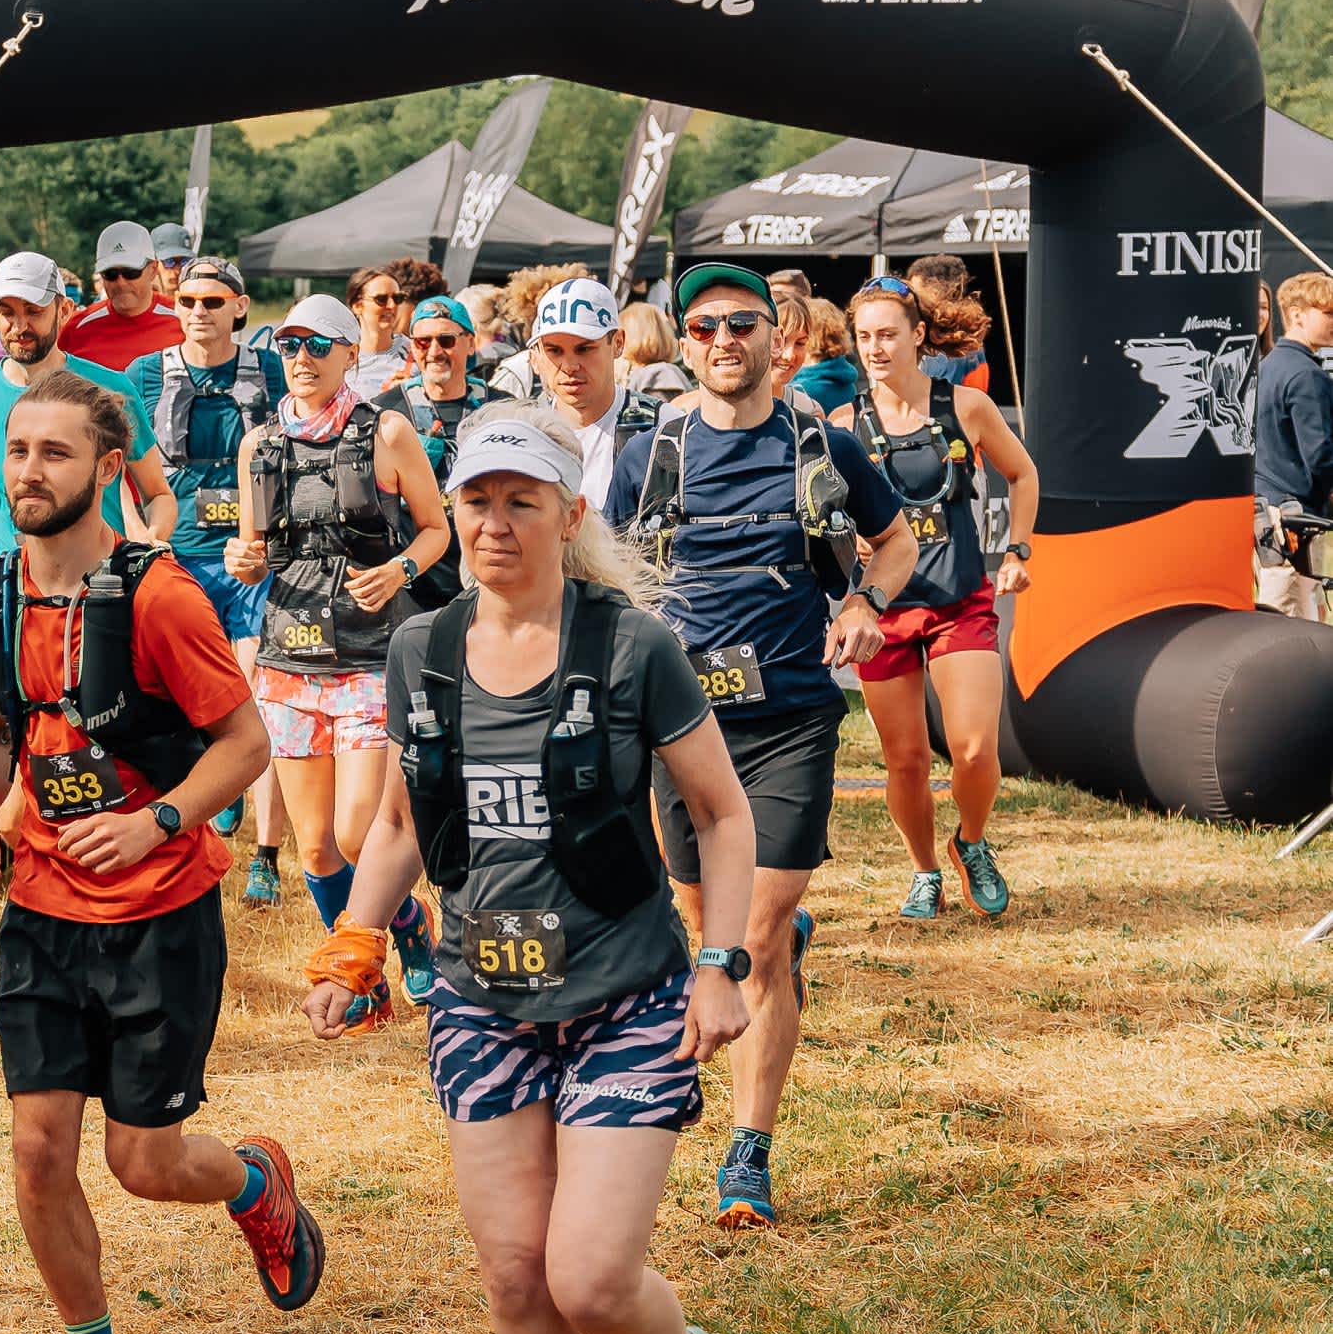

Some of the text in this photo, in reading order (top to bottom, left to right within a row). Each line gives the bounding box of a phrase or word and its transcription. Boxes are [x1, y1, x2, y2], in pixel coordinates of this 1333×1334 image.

[1117, 229, 1261, 275] FINISH
[1181, 316, 1232, 333] Maverick
[205, 502, 239, 521] 363
[284, 624, 323, 647] 368
[43, 772, 103, 805] 353
[479, 939, 546, 973] 518
